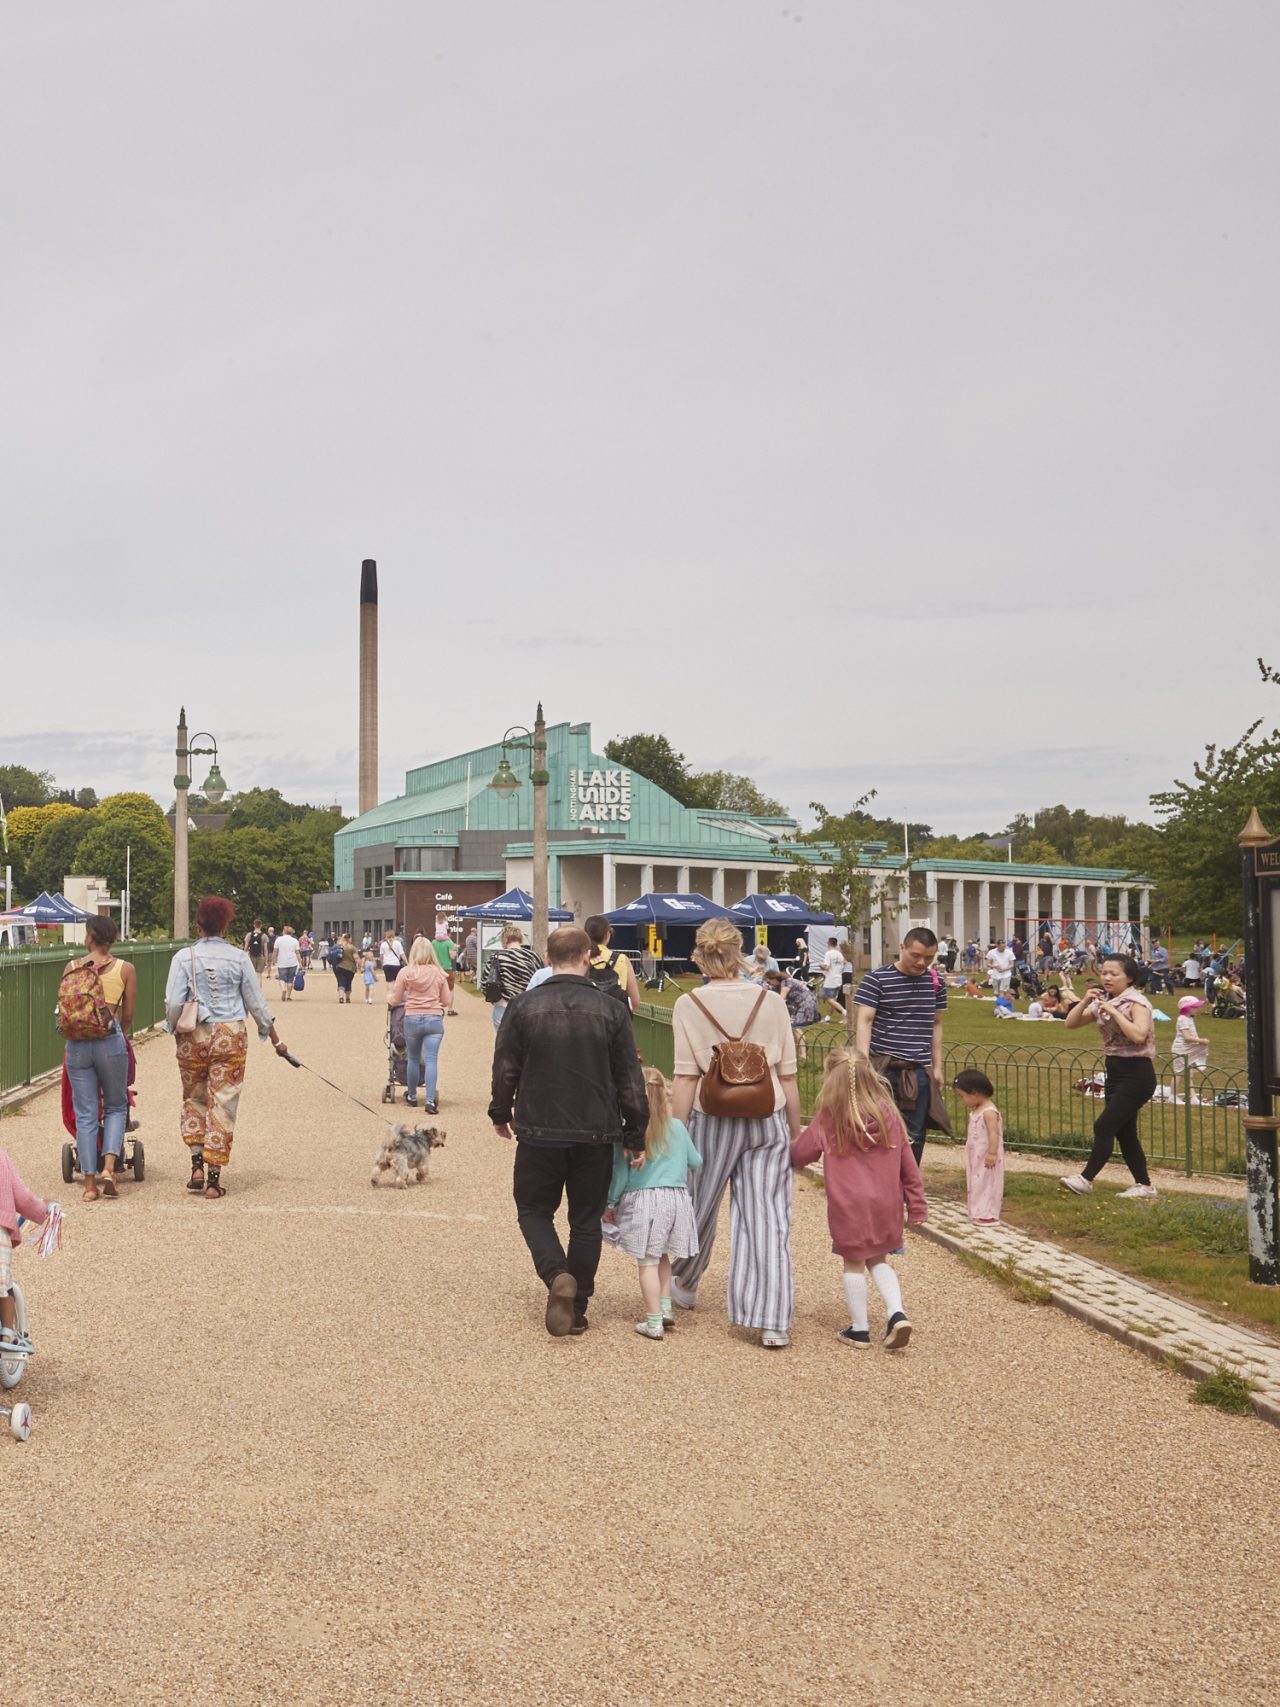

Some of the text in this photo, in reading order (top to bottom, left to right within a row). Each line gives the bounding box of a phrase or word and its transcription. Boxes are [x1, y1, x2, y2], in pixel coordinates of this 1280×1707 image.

[578, 770, 631, 786] LAKE
[579, 804, 631, 820] ARTS
[435, 892, 453, 900] Café
